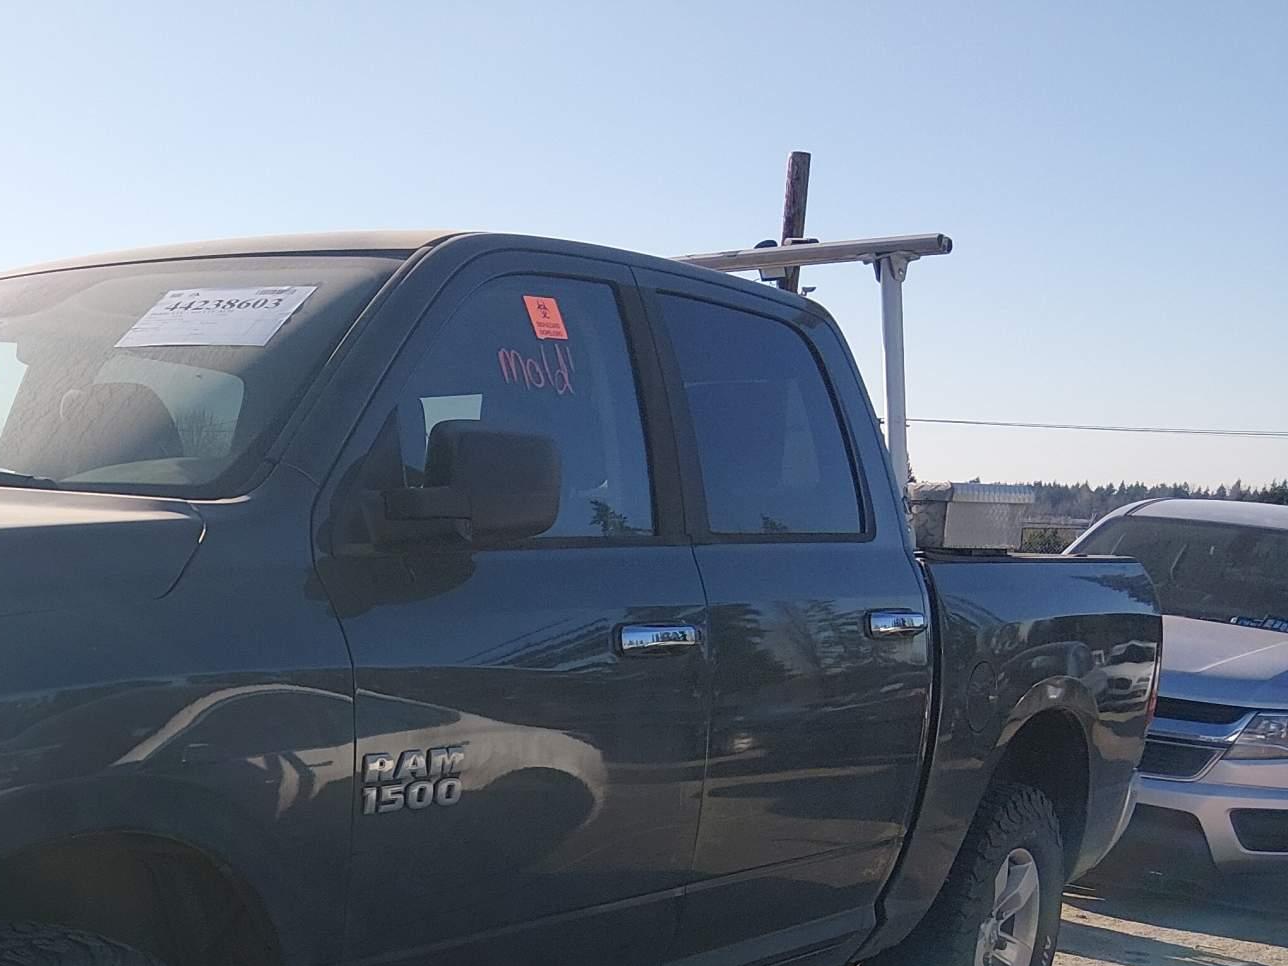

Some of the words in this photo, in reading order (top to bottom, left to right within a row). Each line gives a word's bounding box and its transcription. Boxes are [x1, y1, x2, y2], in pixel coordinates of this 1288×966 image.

[165, 297, 283, 313] 44238603
[362, 746, 465, 782] RAM
[362, 778, 462, 815] 1500
